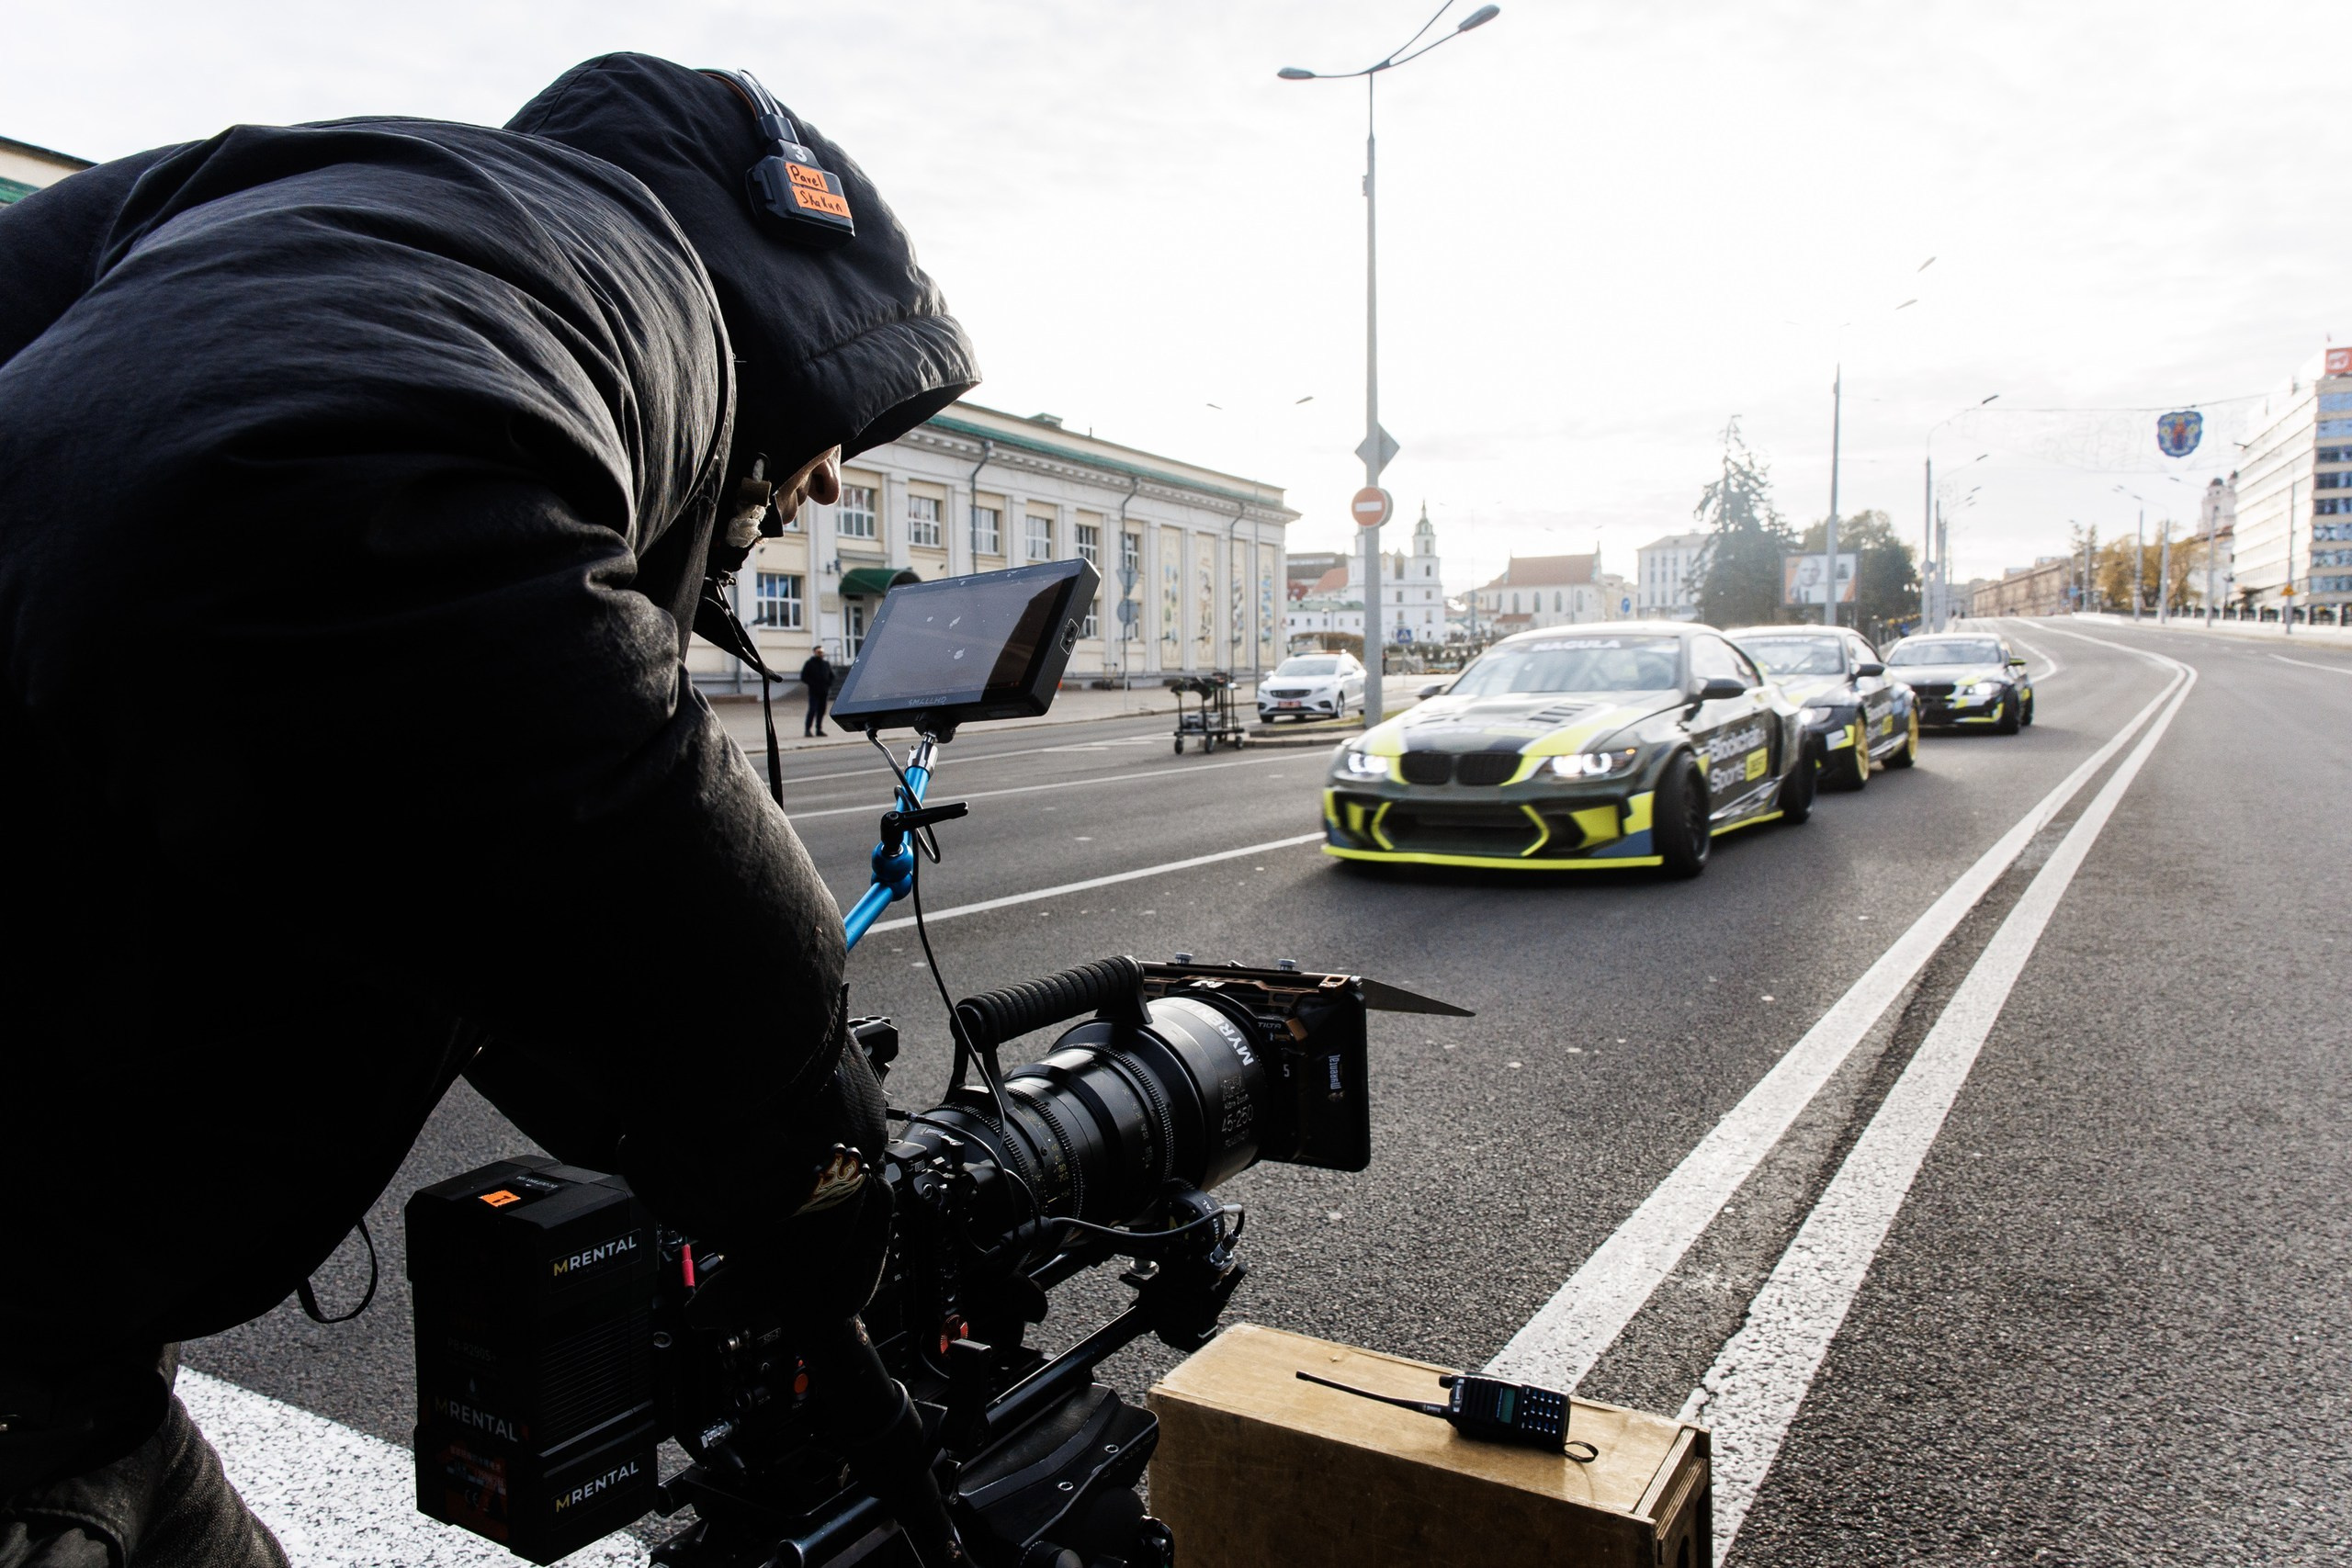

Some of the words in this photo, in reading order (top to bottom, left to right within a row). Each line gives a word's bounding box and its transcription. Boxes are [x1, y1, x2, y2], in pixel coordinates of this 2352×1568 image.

[791, 144, 808, 163] 3
[789, 164, 824, 189] Pavel
[1710, 761, 1746, 795] Sports
[1257, 1021, 1283, 1030] TILTA
[1283, 1063, 1291, 1078] 5
[1221, 1103, 1254, 1133] 45-250
[553, 1235, 638, 1278] MRENTAL
[434, 1395, 519, 1443] MRENTAL
[556, 1461, 639, 1514] MRENTAL
